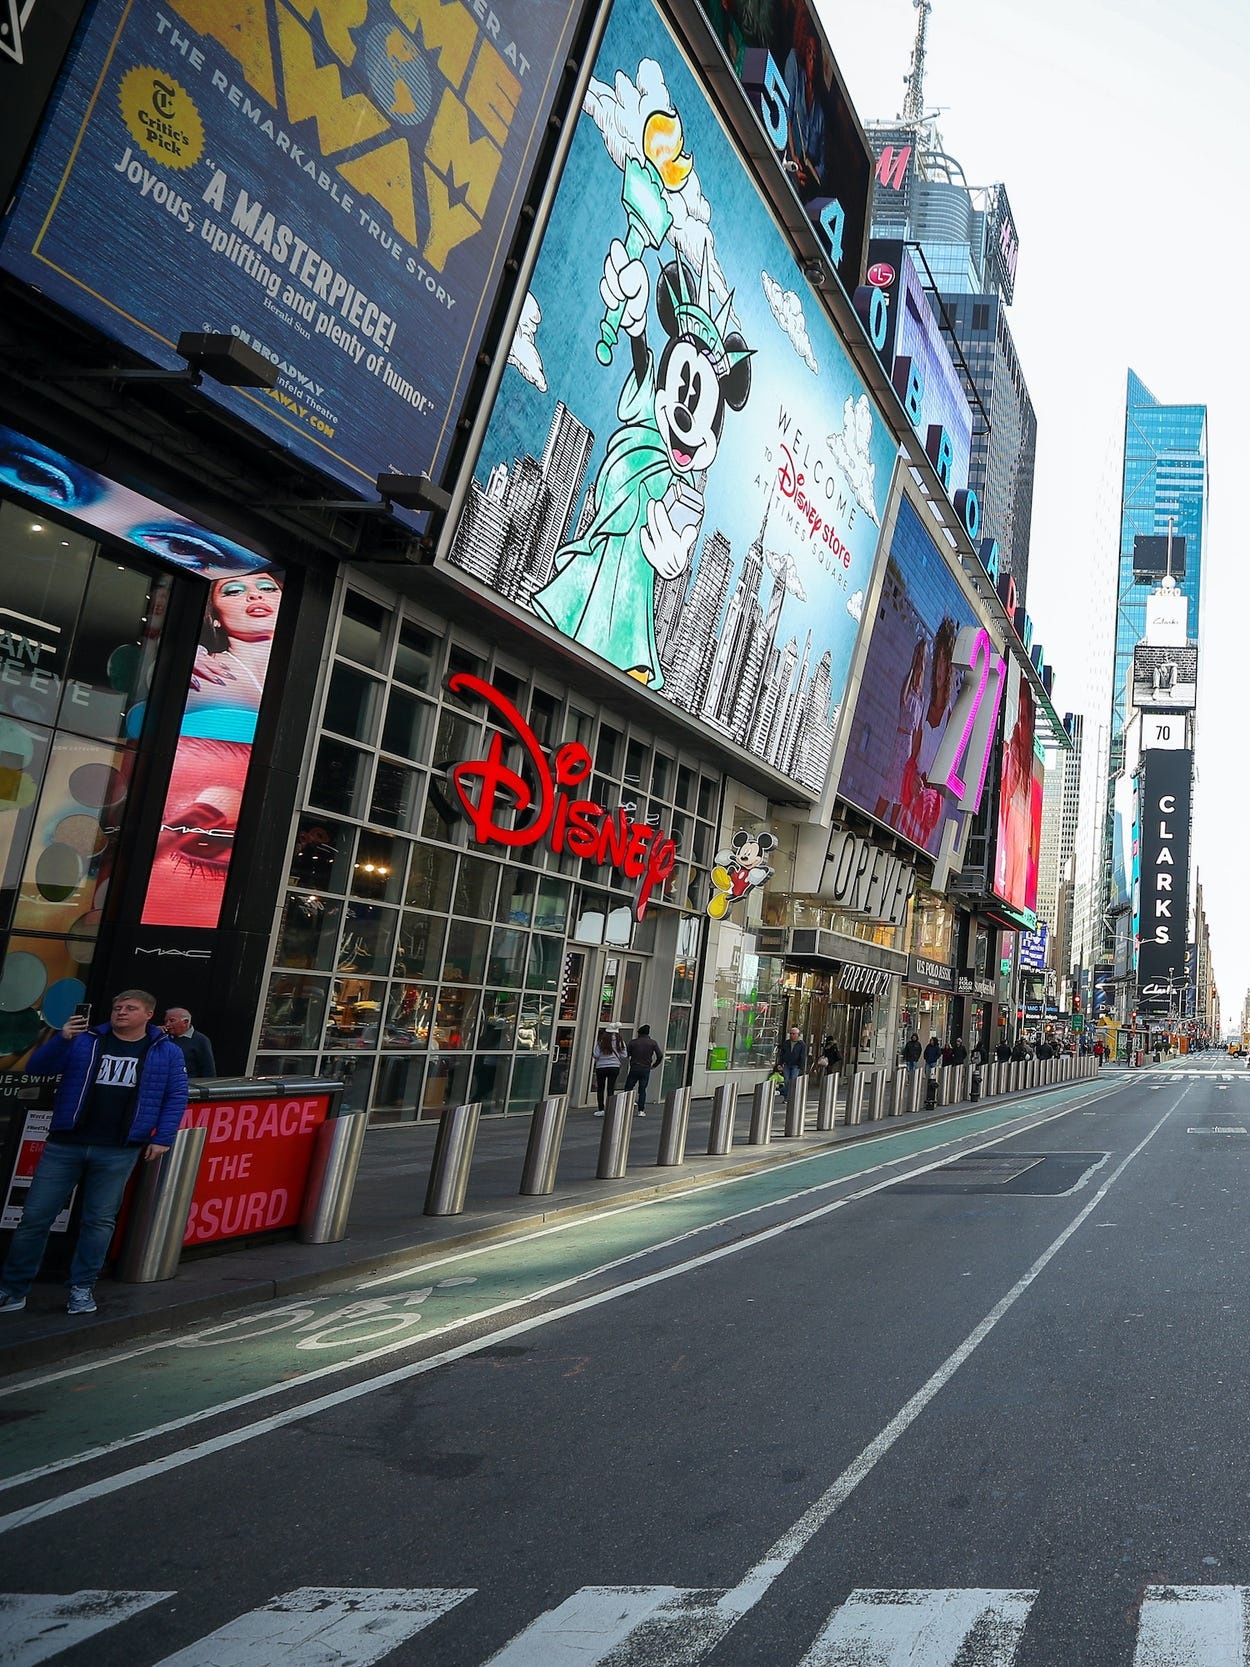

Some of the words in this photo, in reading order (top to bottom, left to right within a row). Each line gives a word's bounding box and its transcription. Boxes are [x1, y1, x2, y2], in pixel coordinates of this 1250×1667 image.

[468, 0, 501, 39] ER
[503, 41, 531, 76] AT
[138, 110, 190, 146] Critic's
[146, 129, 181, 156] Pick
[155, 12, 205, 72] THE
[211, 69, 354, 213] REMARKABLE
[359, 208, 403, 261] TRUE
[405, 257, 456, 311] STORY
[114, 147, 196, 232] Joyous,
[201, 219, 281, 296] uplifting
[283, 285, 317, 322] and
[315, 311, 367, 364] plenty
[366, 352, 386, 376] of
[231, 189, 398, 352] MASTERPIECE!
[263, 298, 293, 326] Herald
[294, 320, 311, 340] Sun
[252, 340, 325, 397] BROADWAY
[263, 388, 335, 439] AWAY.COM
[277, 376, 303, 398] nfeld
[306, 394, 338, 424] Theatre
[764, 446, 772, 462] TO
[778, 404, 857, 530] WELCOME
[754, 474, 768, 495] AT
[775, 496, 805, 542] TIMES
[812, 543, 847, 592] SQUARE
[822, 524, 850, 568] store
[1155, 587, 1181, 597] 2020
[942, 626, 1008, 816] 21
[1156, 725, 1170, 741] 70
[817, 819, 918, 928] FOREVER
[1155, 795, 1176, 944] CLARKS
[838, 964, 880, 995] FOREVER
[179, 1101, 318, 1143] MBRACE
[208, 1153, 253, 1182] THE
